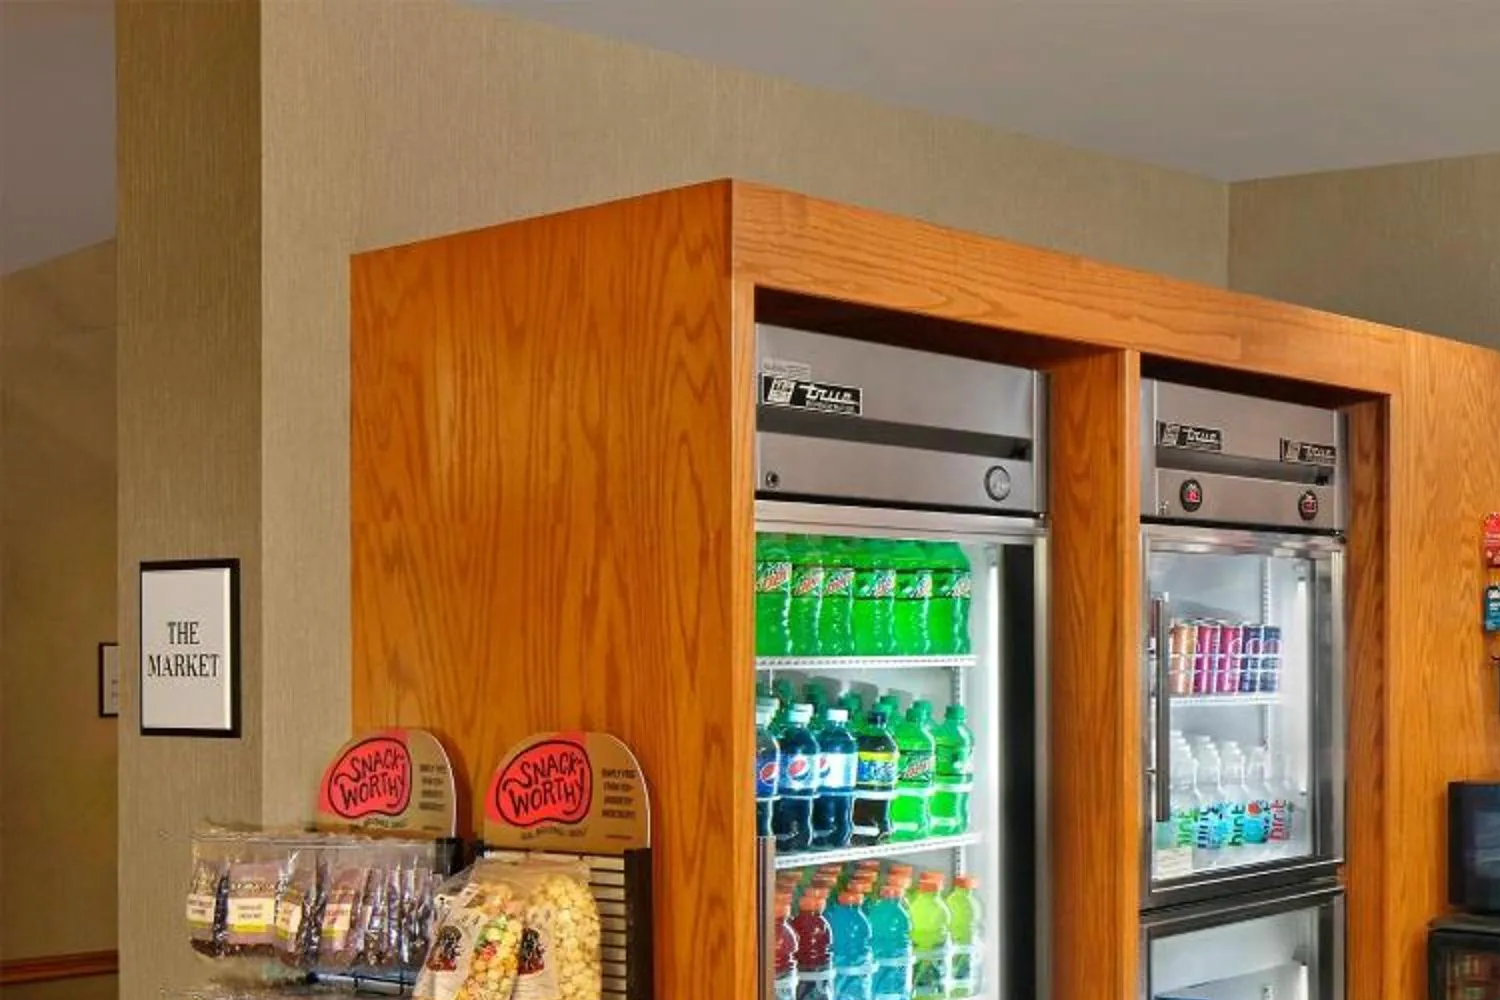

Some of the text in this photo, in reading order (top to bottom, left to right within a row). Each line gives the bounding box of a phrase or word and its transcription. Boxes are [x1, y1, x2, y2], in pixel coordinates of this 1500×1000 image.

[167, 621, 201, 645] THE
[147, 653, 221, 677] MARKET
[334, 764, 407, 810] WORTHY
[502, 767, 585, 817] WORTHY
